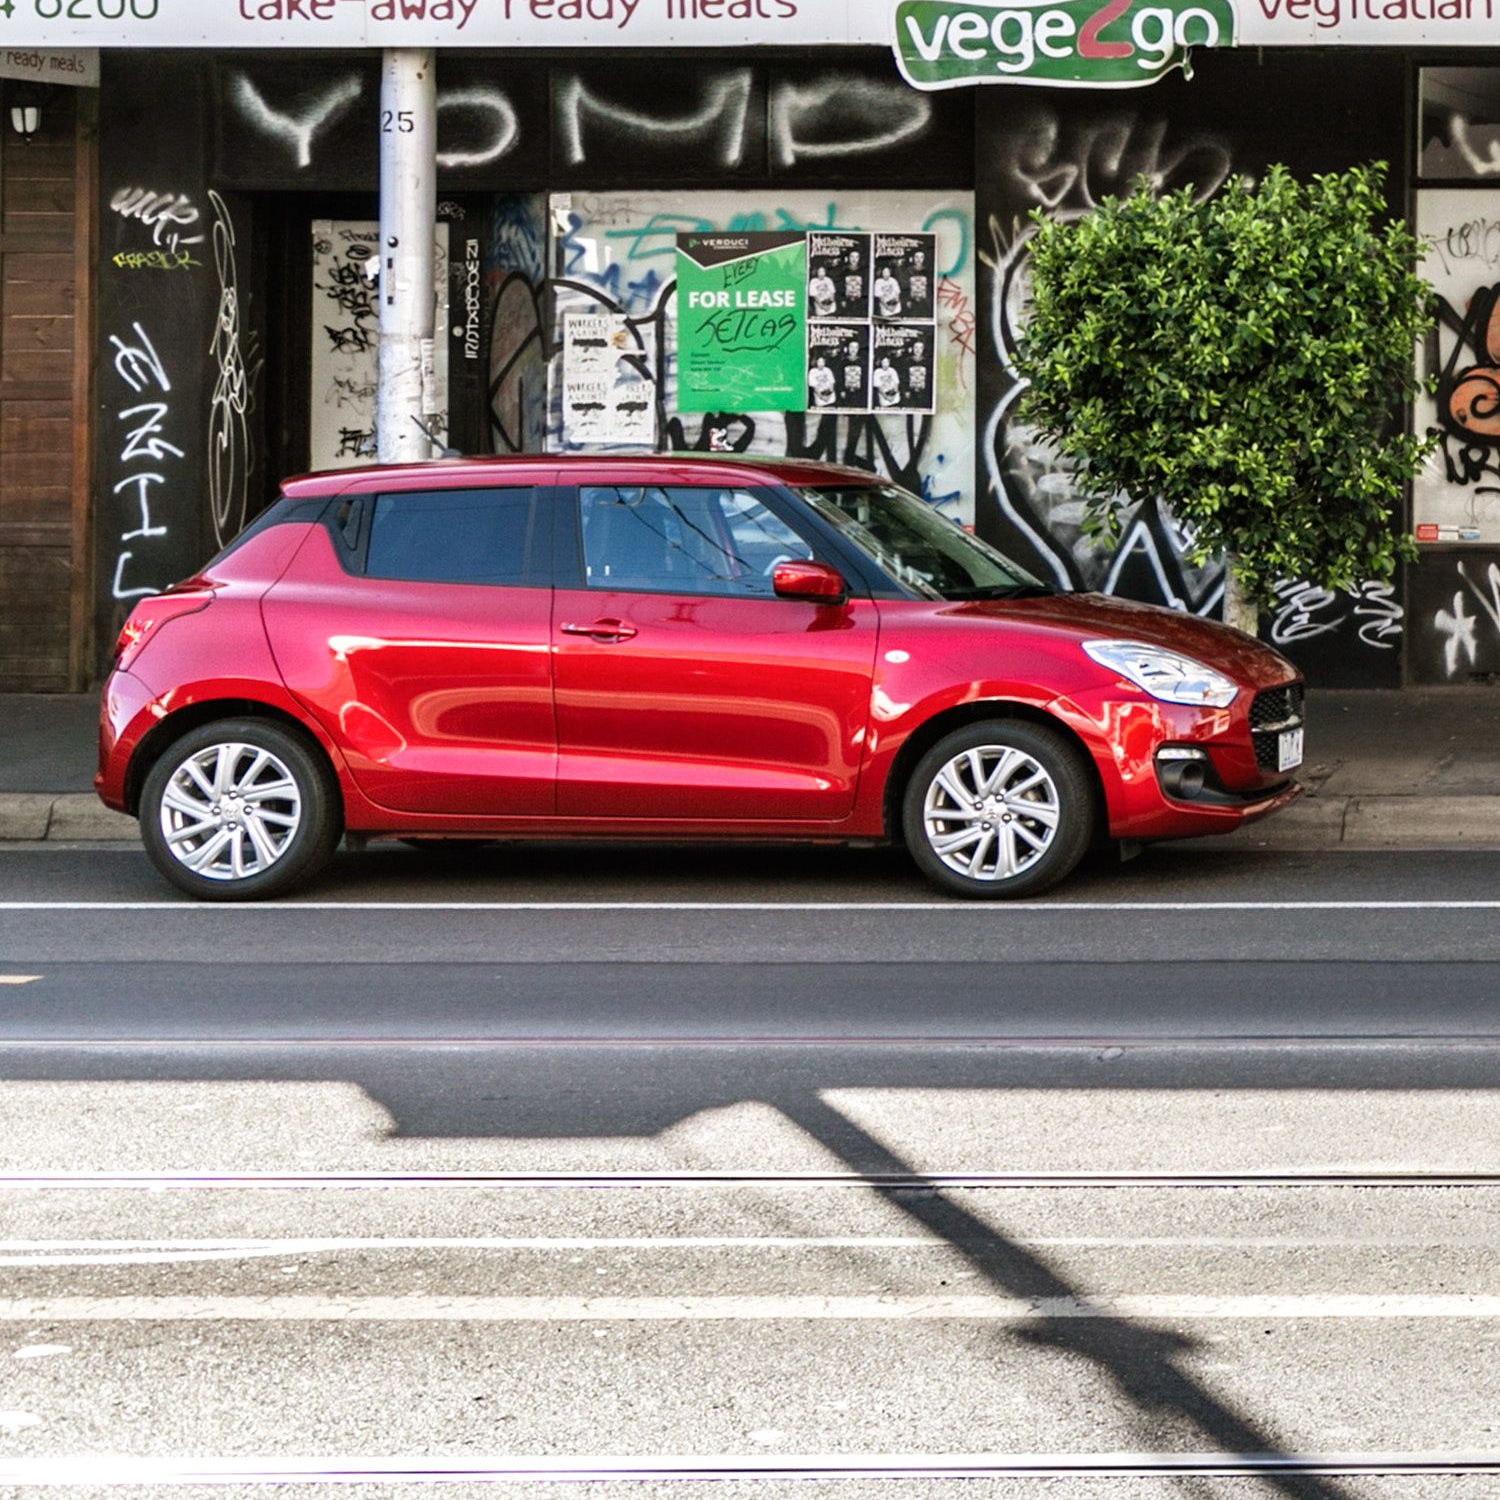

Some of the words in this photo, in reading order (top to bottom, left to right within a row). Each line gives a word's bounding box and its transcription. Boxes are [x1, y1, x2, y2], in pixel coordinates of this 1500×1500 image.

[6, 51, 46, 71] ready
[51, 56, 85, 73] meals
[382, 110, 415, 133] 25
[701, 238, 749, 247] VERDUCI
[688, 291, 731, 309] FOR
[736, 290, 796, 308] LEASE
